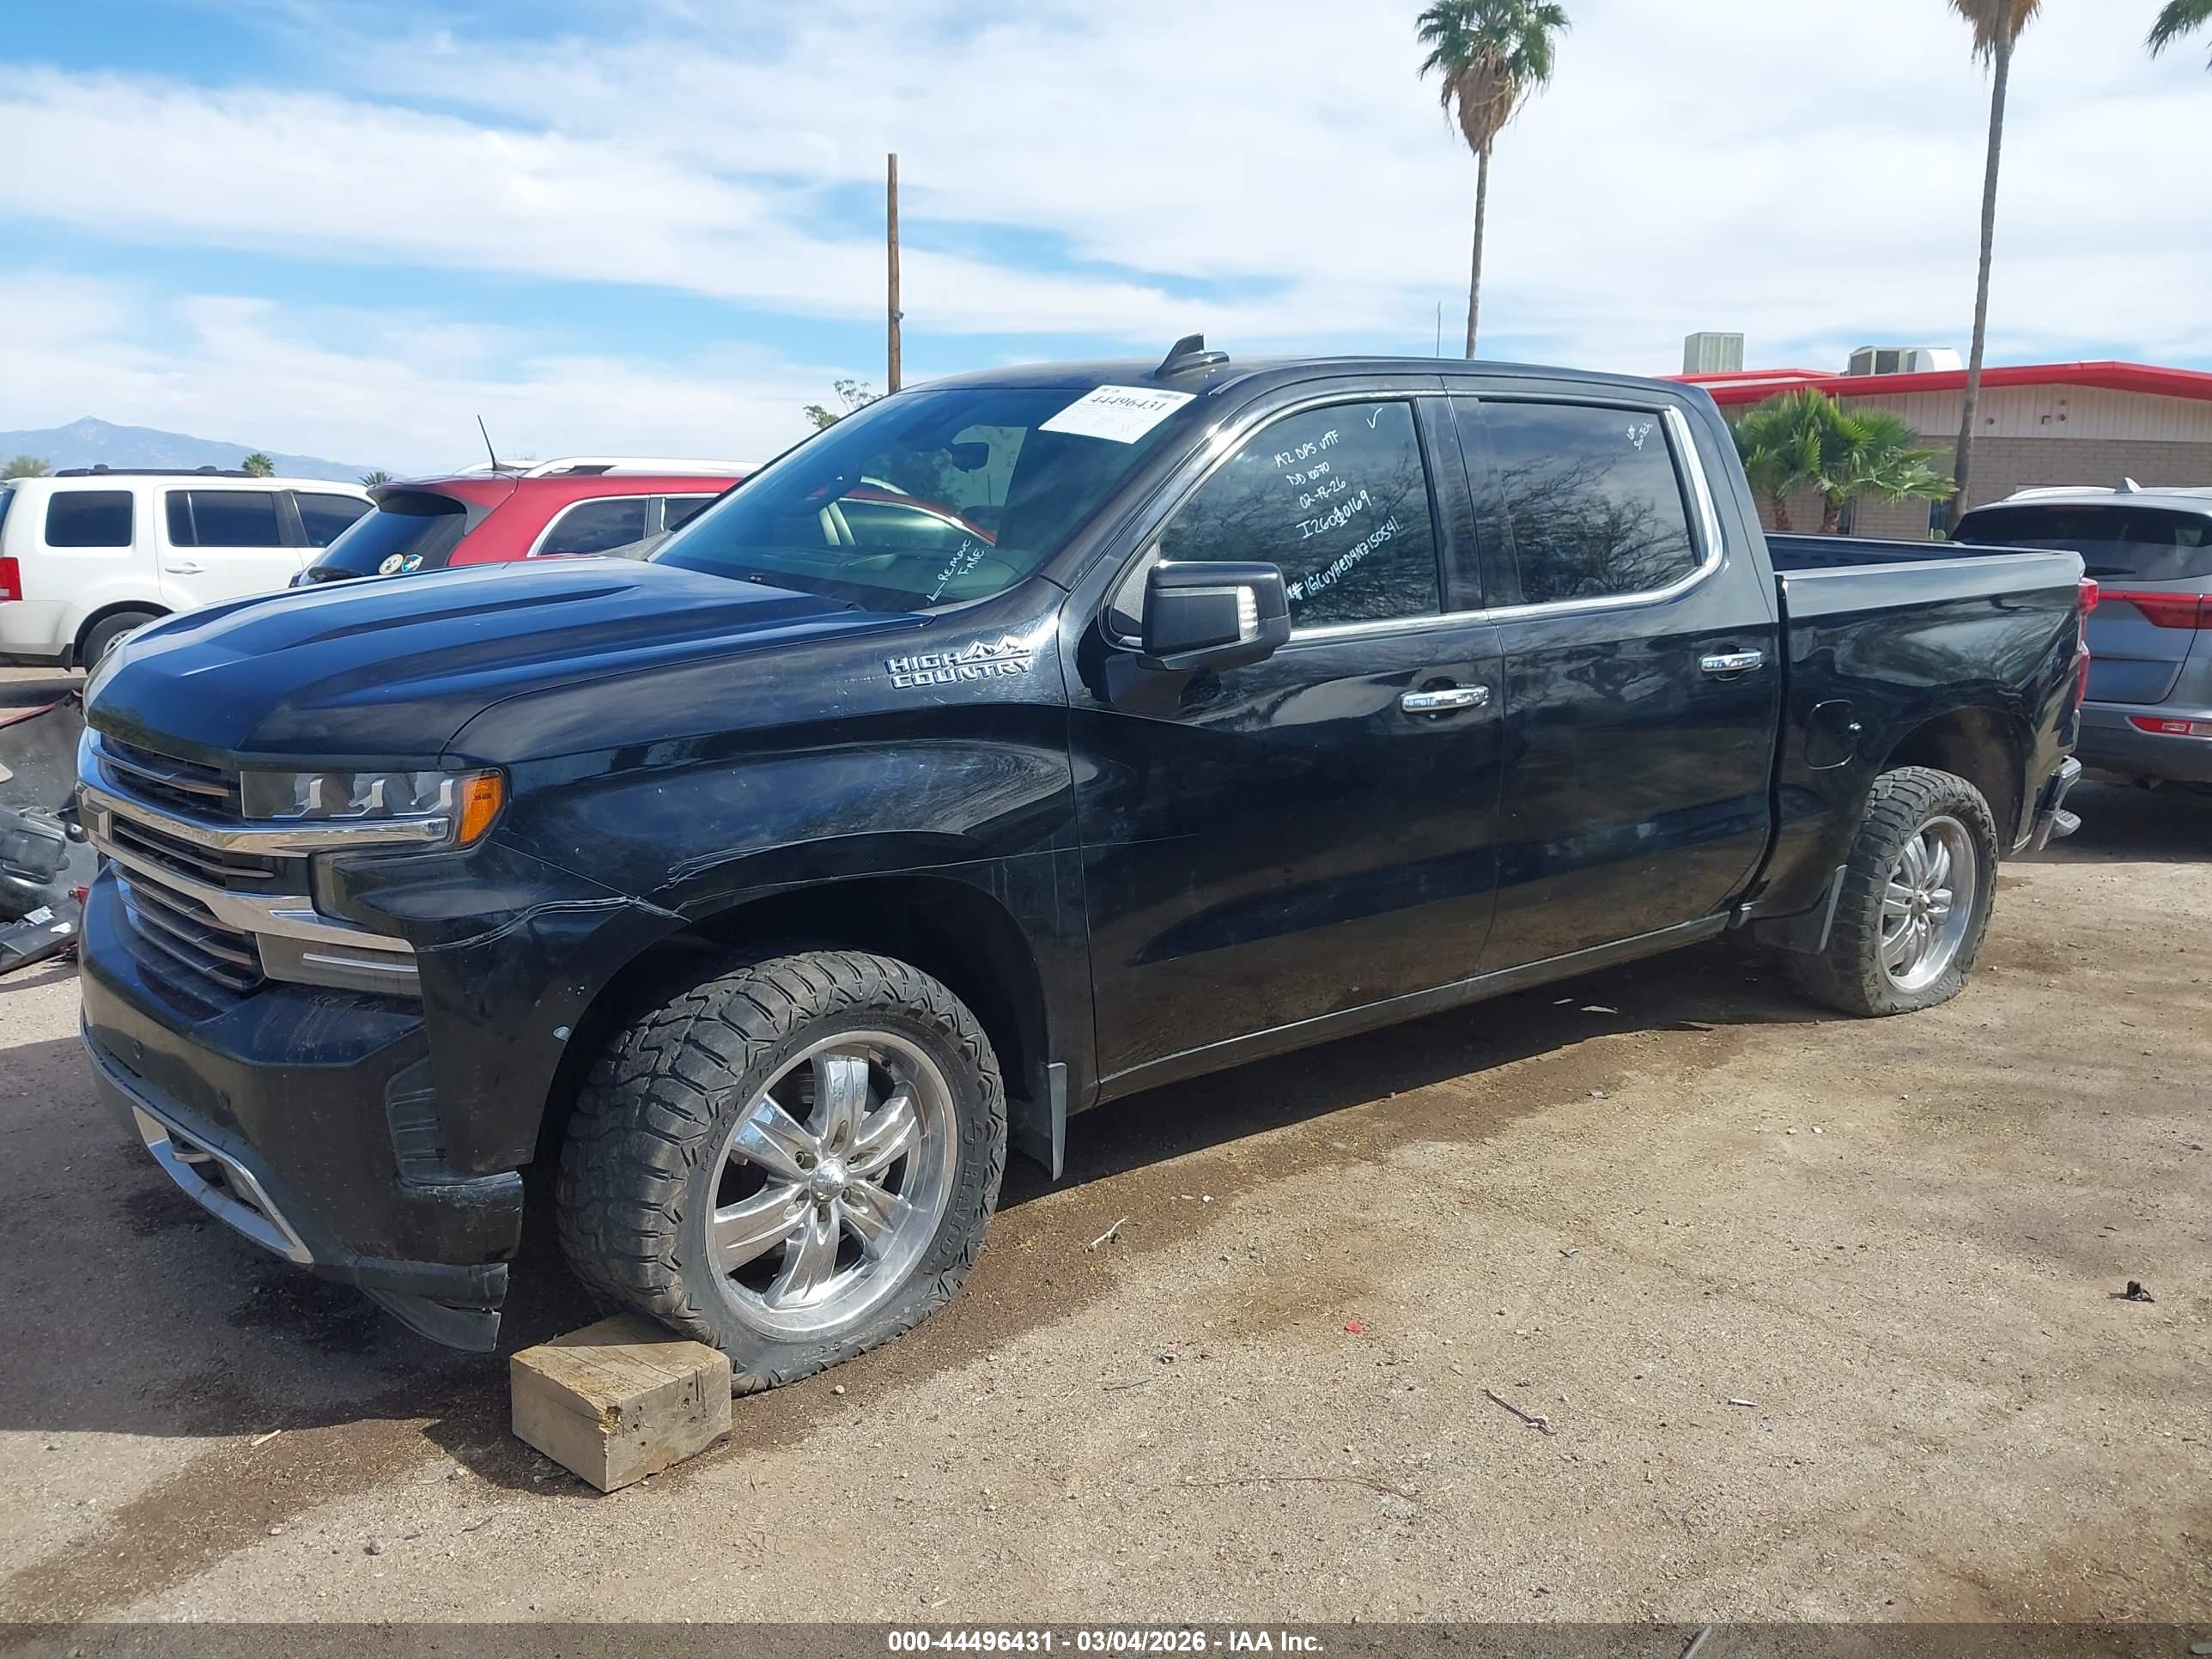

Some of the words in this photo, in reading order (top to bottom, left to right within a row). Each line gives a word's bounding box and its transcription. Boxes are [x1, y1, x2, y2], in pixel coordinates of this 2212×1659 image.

[1091, 394, 1168, 411] 44496431
[1295, 441, 1317, 460] DPS
[1285, 471, 1307, 486] DD
[1298, 476, 1347, 509] 02-18-26
[884, 651, 962, 675] HIGH
[890, 658, 1034, 690] COUNTRY
